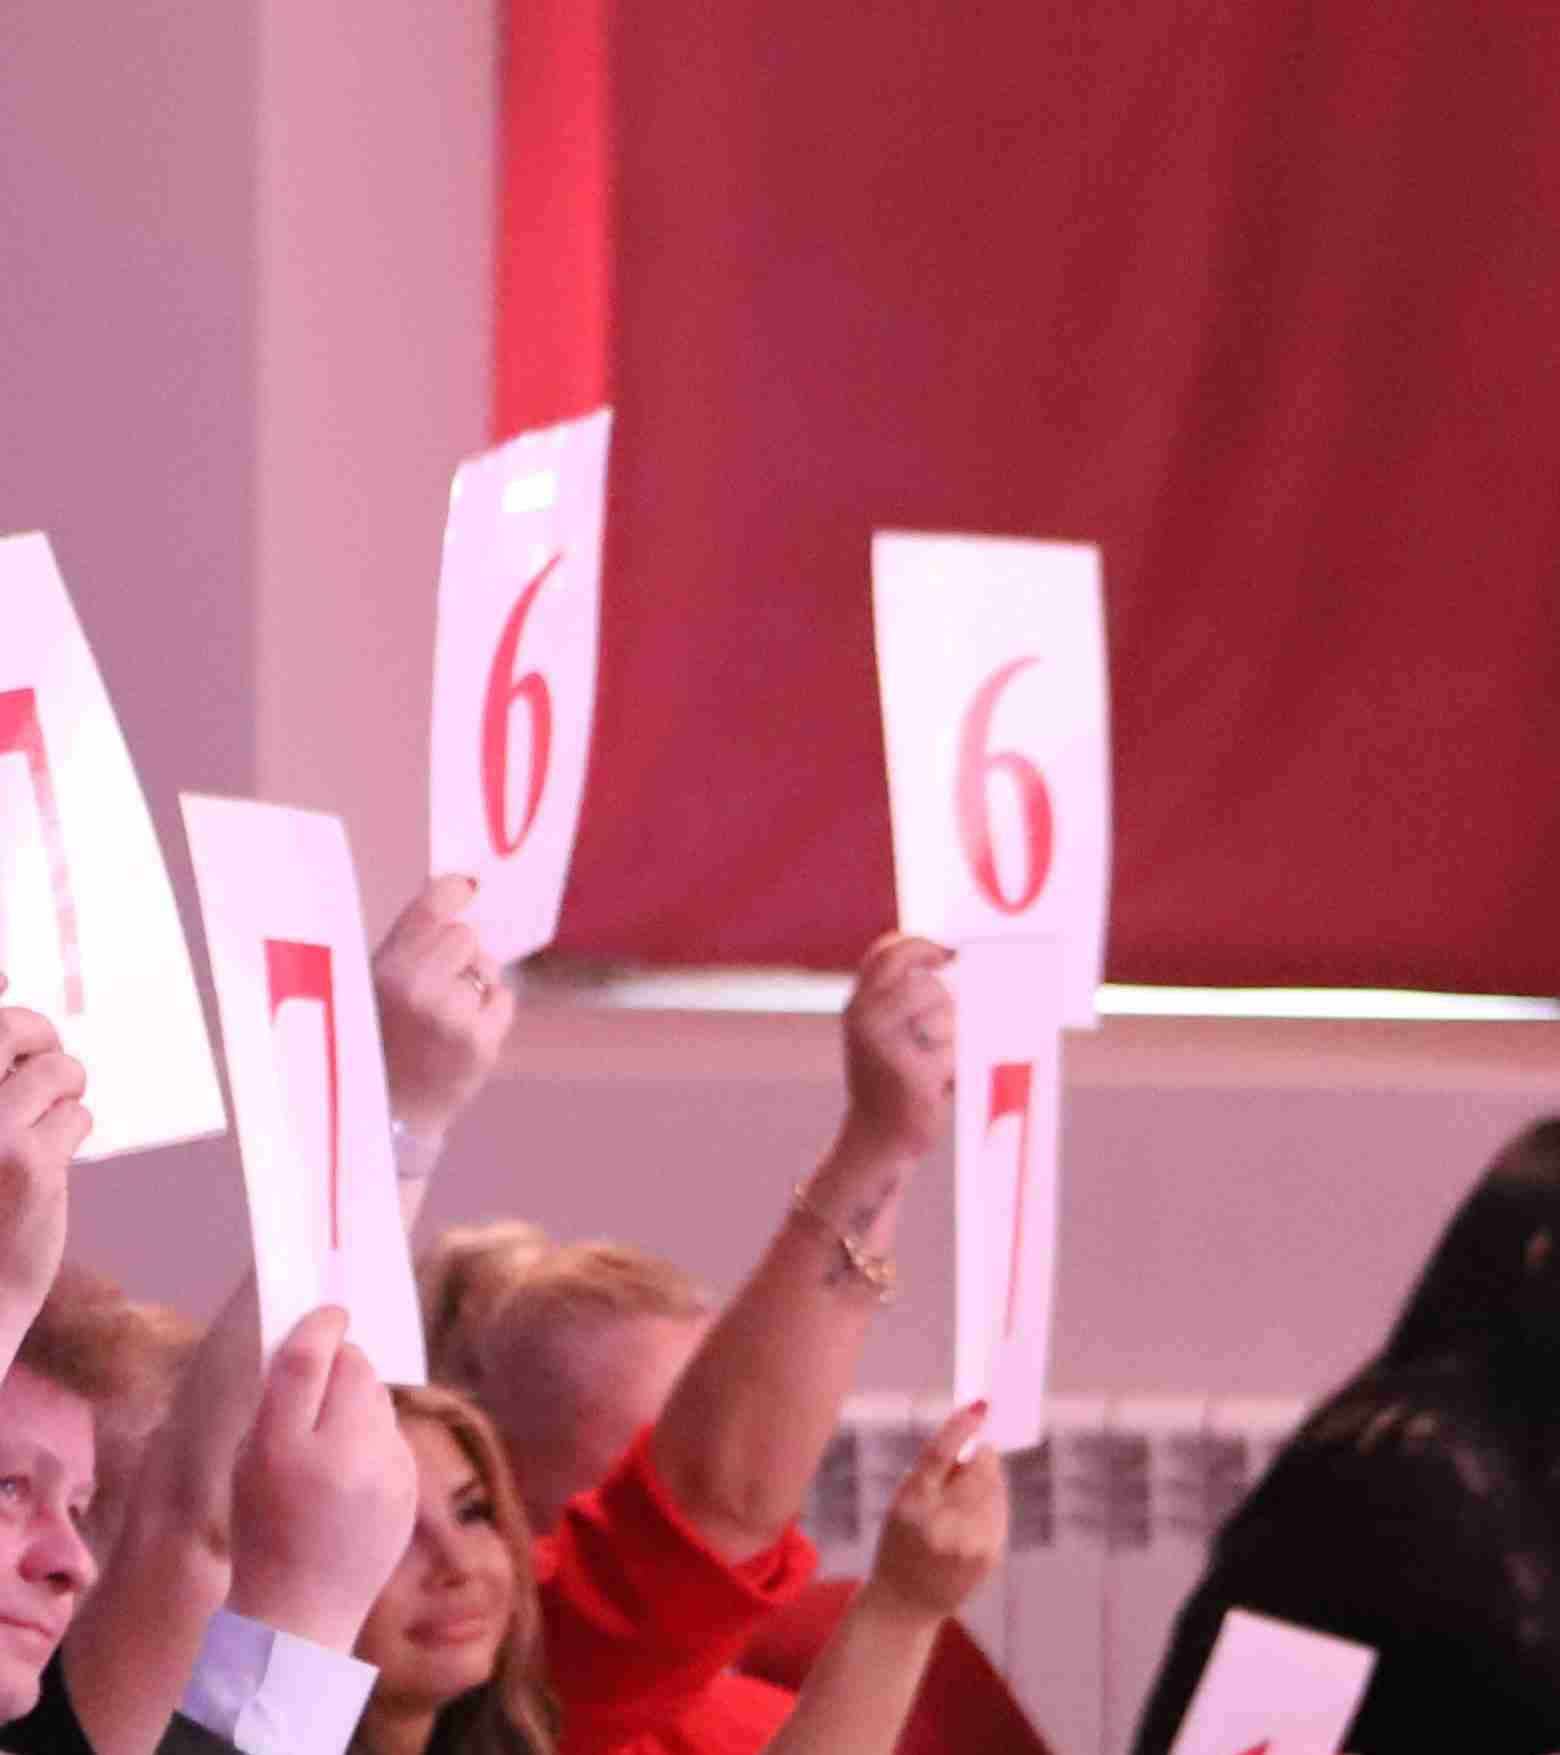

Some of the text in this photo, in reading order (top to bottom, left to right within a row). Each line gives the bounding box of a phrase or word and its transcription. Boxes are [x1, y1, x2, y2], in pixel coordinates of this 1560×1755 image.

[480, 551, 564, 858] 6
[955, 655, 1054, 914] 6
[263, 938, 340, 1252] 7
[982, 1061, 1034, 1342] 7
